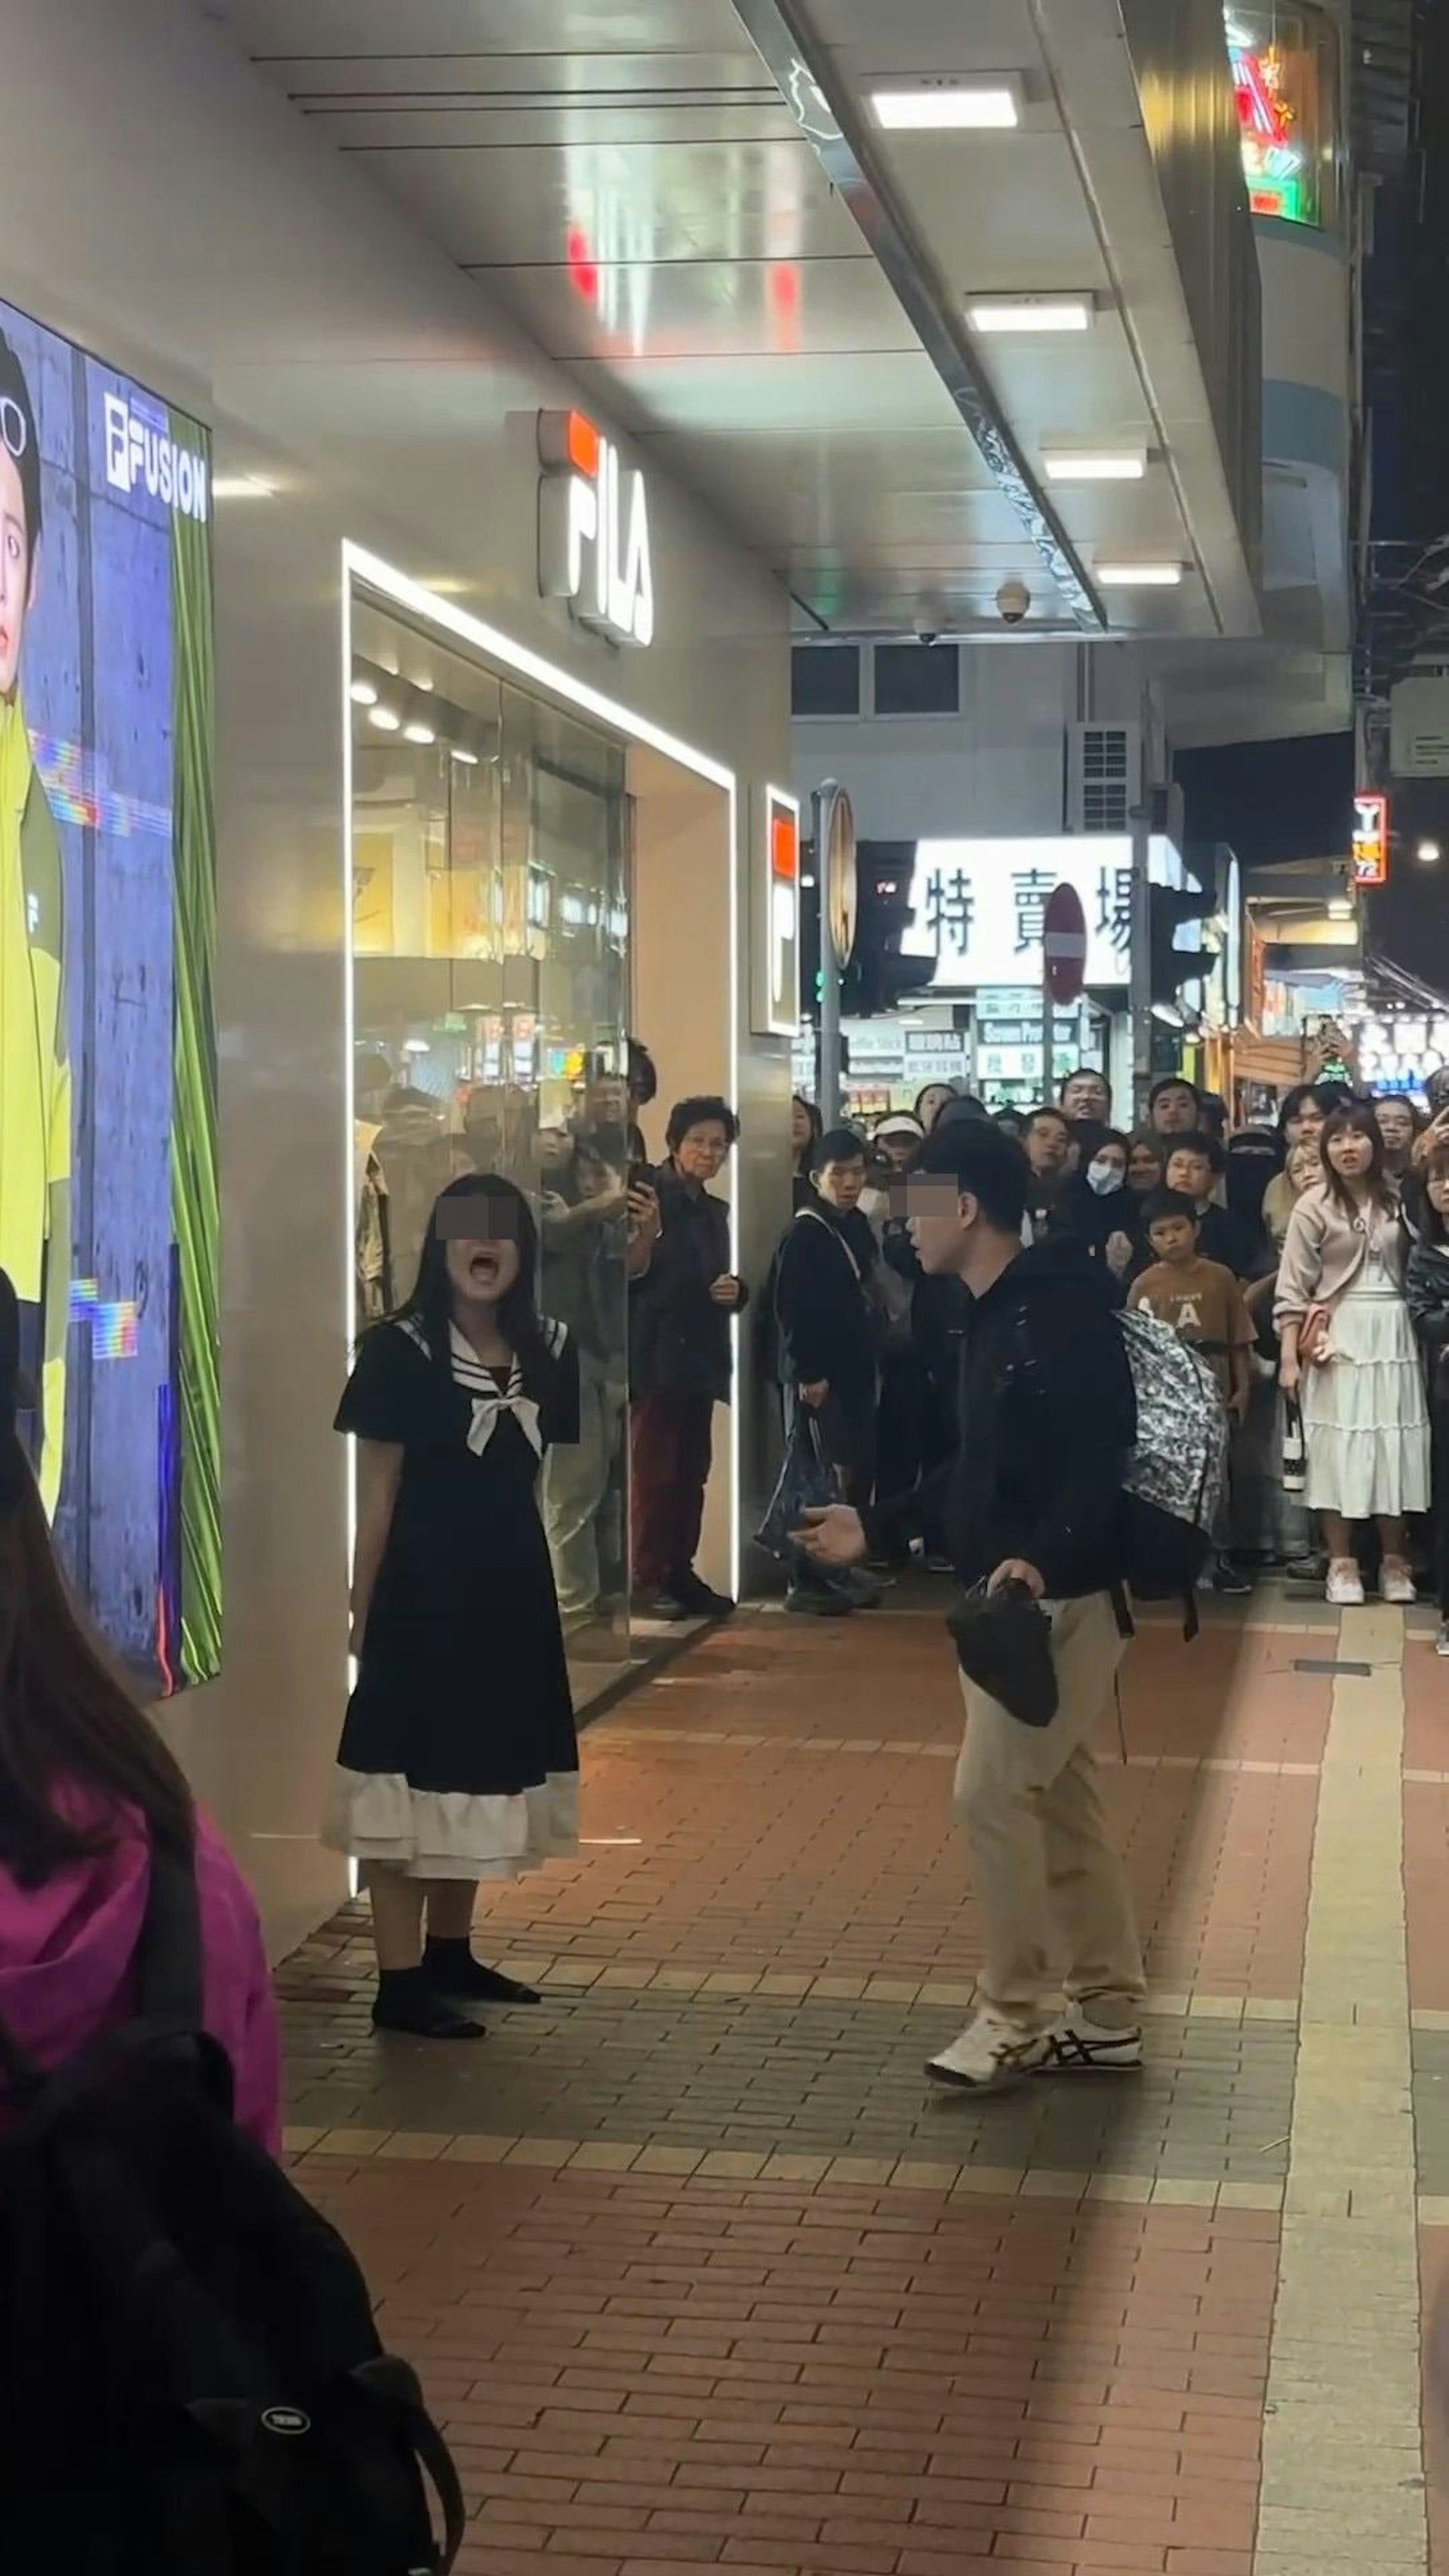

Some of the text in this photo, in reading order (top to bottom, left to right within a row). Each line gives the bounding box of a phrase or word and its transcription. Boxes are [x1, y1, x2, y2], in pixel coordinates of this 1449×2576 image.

[568, 408, 654, 647] FILA
[926, 866, 1136, 956] 特賣場
